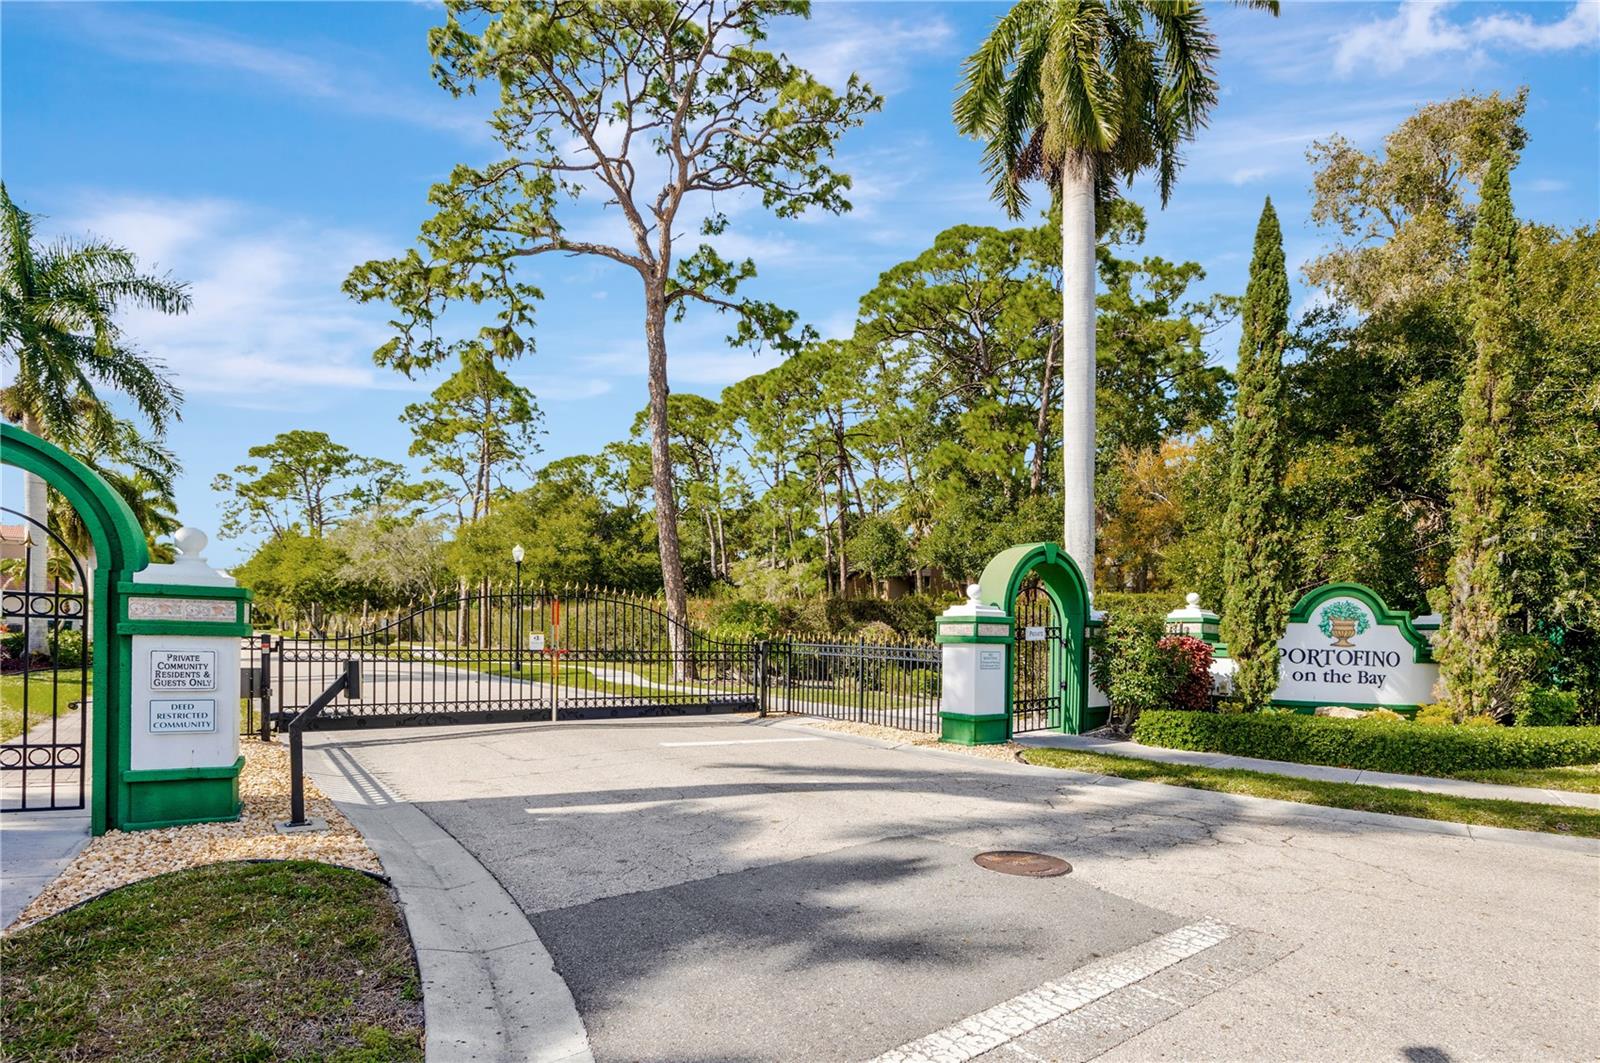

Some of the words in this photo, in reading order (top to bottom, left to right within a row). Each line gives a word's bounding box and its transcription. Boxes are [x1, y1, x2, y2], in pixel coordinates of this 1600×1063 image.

[157, 662, 208, 670] COMMUNITY
[155, 670, 201, 678] RESIDENTS
[203, 670, 210, 678] &
[153, 678, 187, 687] GUESTS
[189, 678, 212, 687] ONLY
[1292, 671, 1316, 682] on
[1323, 669, 1352, 684] the
[1357, 670, 1386, 688] Bay
